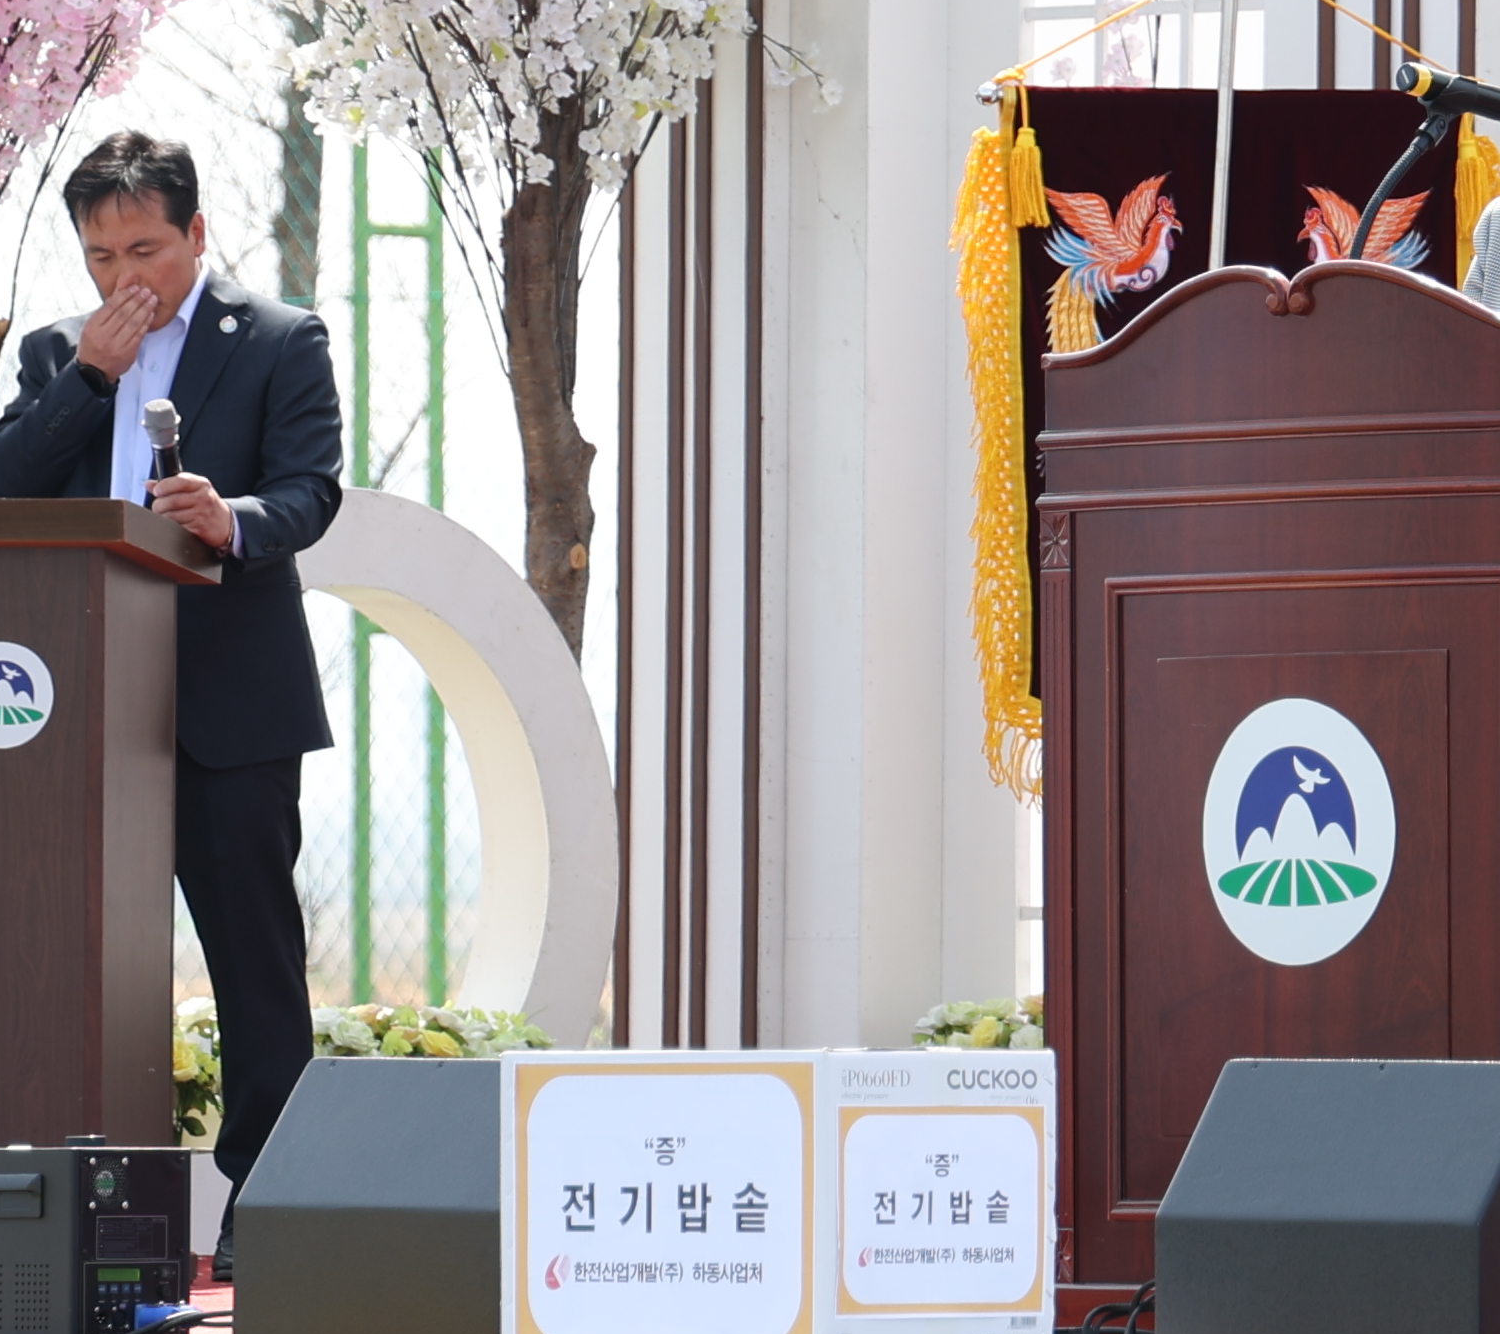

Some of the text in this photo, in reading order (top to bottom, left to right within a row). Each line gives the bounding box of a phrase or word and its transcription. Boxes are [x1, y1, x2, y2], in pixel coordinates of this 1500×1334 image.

[946, 1069, 1038, 1090] CUCKOO
[962, 1247, 1014, 1264] 하동사업처
[573, 1261, 763, 1285] 한전산업개발(주) 하동사업처
